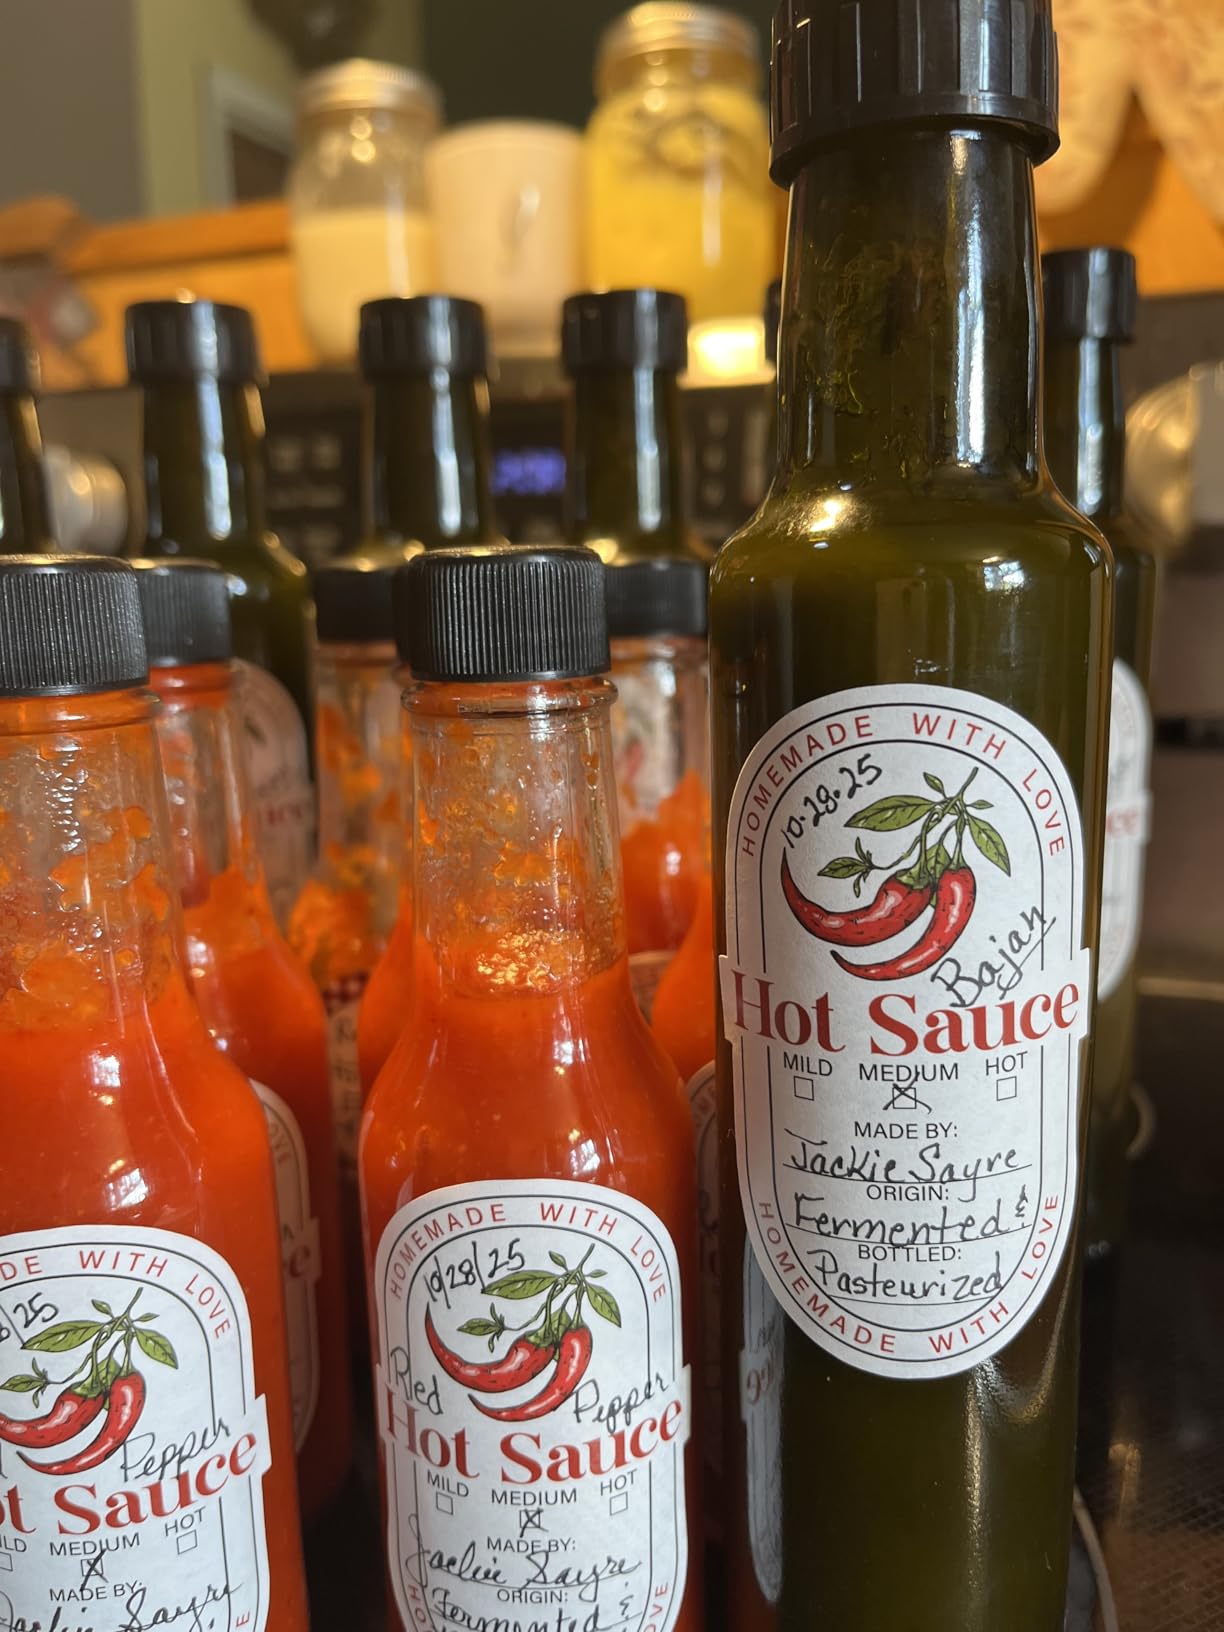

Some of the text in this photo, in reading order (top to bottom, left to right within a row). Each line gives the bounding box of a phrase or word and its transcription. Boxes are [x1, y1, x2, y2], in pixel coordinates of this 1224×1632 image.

[743, 712, 1065, 857] HOMEMADE WITH LOVE
[930, 906, 1057, 1008] Bajan
[731, 970, 1079, 1057] Hot Sauce
[783, 1051, 1028, 1082] MILD MEDIUM HOT
[854, 1122, 958, 1139] MADE BY:
[784, 1128, 1018, 1203] Jackie Sayre
[866, 1184, 950, 1202] ORIGIN:
[794, 1193, 1009, 1249] Fermented
[389, 1203, 507, 1300] HOMEMADE
[540, 1202, 618, 1236] WITH
[630, 1235, 667, 1304] LOVE
[759, 1201, 897, 1354] HOMEMADE
[928, 1302, 1010, 1354] WITH
[1021, 1195, 1059, 1281] LOVE
[806, 1250, 1002, 1301] Pasteurized
[858, 1246, 962, 1263] BOTTLED:
[79, 1250, 168, 1277] WITH
[185, 1273, 231, 1340] LOVE
[390, 1346, 443, 1416] Red
[386, 1385, 683, 1485] Hot Sauce
[53, 1432, 257, 1536] Sauce
[426, 1469, 637, 1507] MILD MEDIUM HOT
[49, 1532, 140, 1556] MEDIUM
[165, 1506, 206, 1537] HOT
[487, 1536, 576, 1554] MADE BY:
[49, 1586, 108, 1602] MADE
[497, 1588, 569, 1605] ORIGIN:
